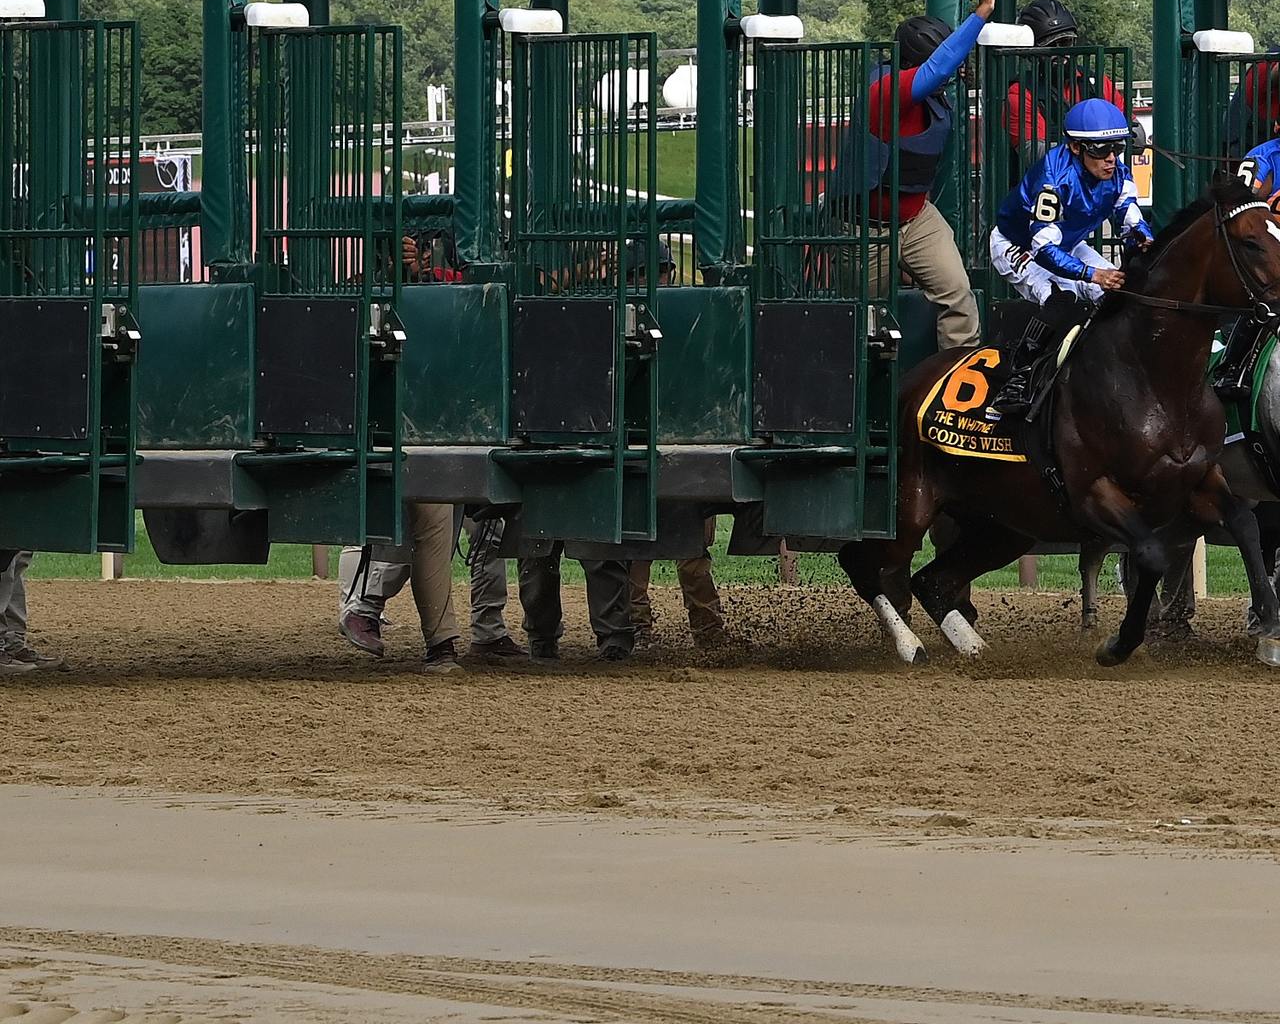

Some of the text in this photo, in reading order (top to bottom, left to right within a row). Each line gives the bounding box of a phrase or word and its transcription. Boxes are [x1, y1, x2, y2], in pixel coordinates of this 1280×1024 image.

[1237, 161, 1255, 188] 5
[1035, 192, 1058, 222] 6
[941, 348, 1001, 413] 6
[933, 410, 956, 426] THE
[928, 426, 1013, 452] CODY'S WISH
